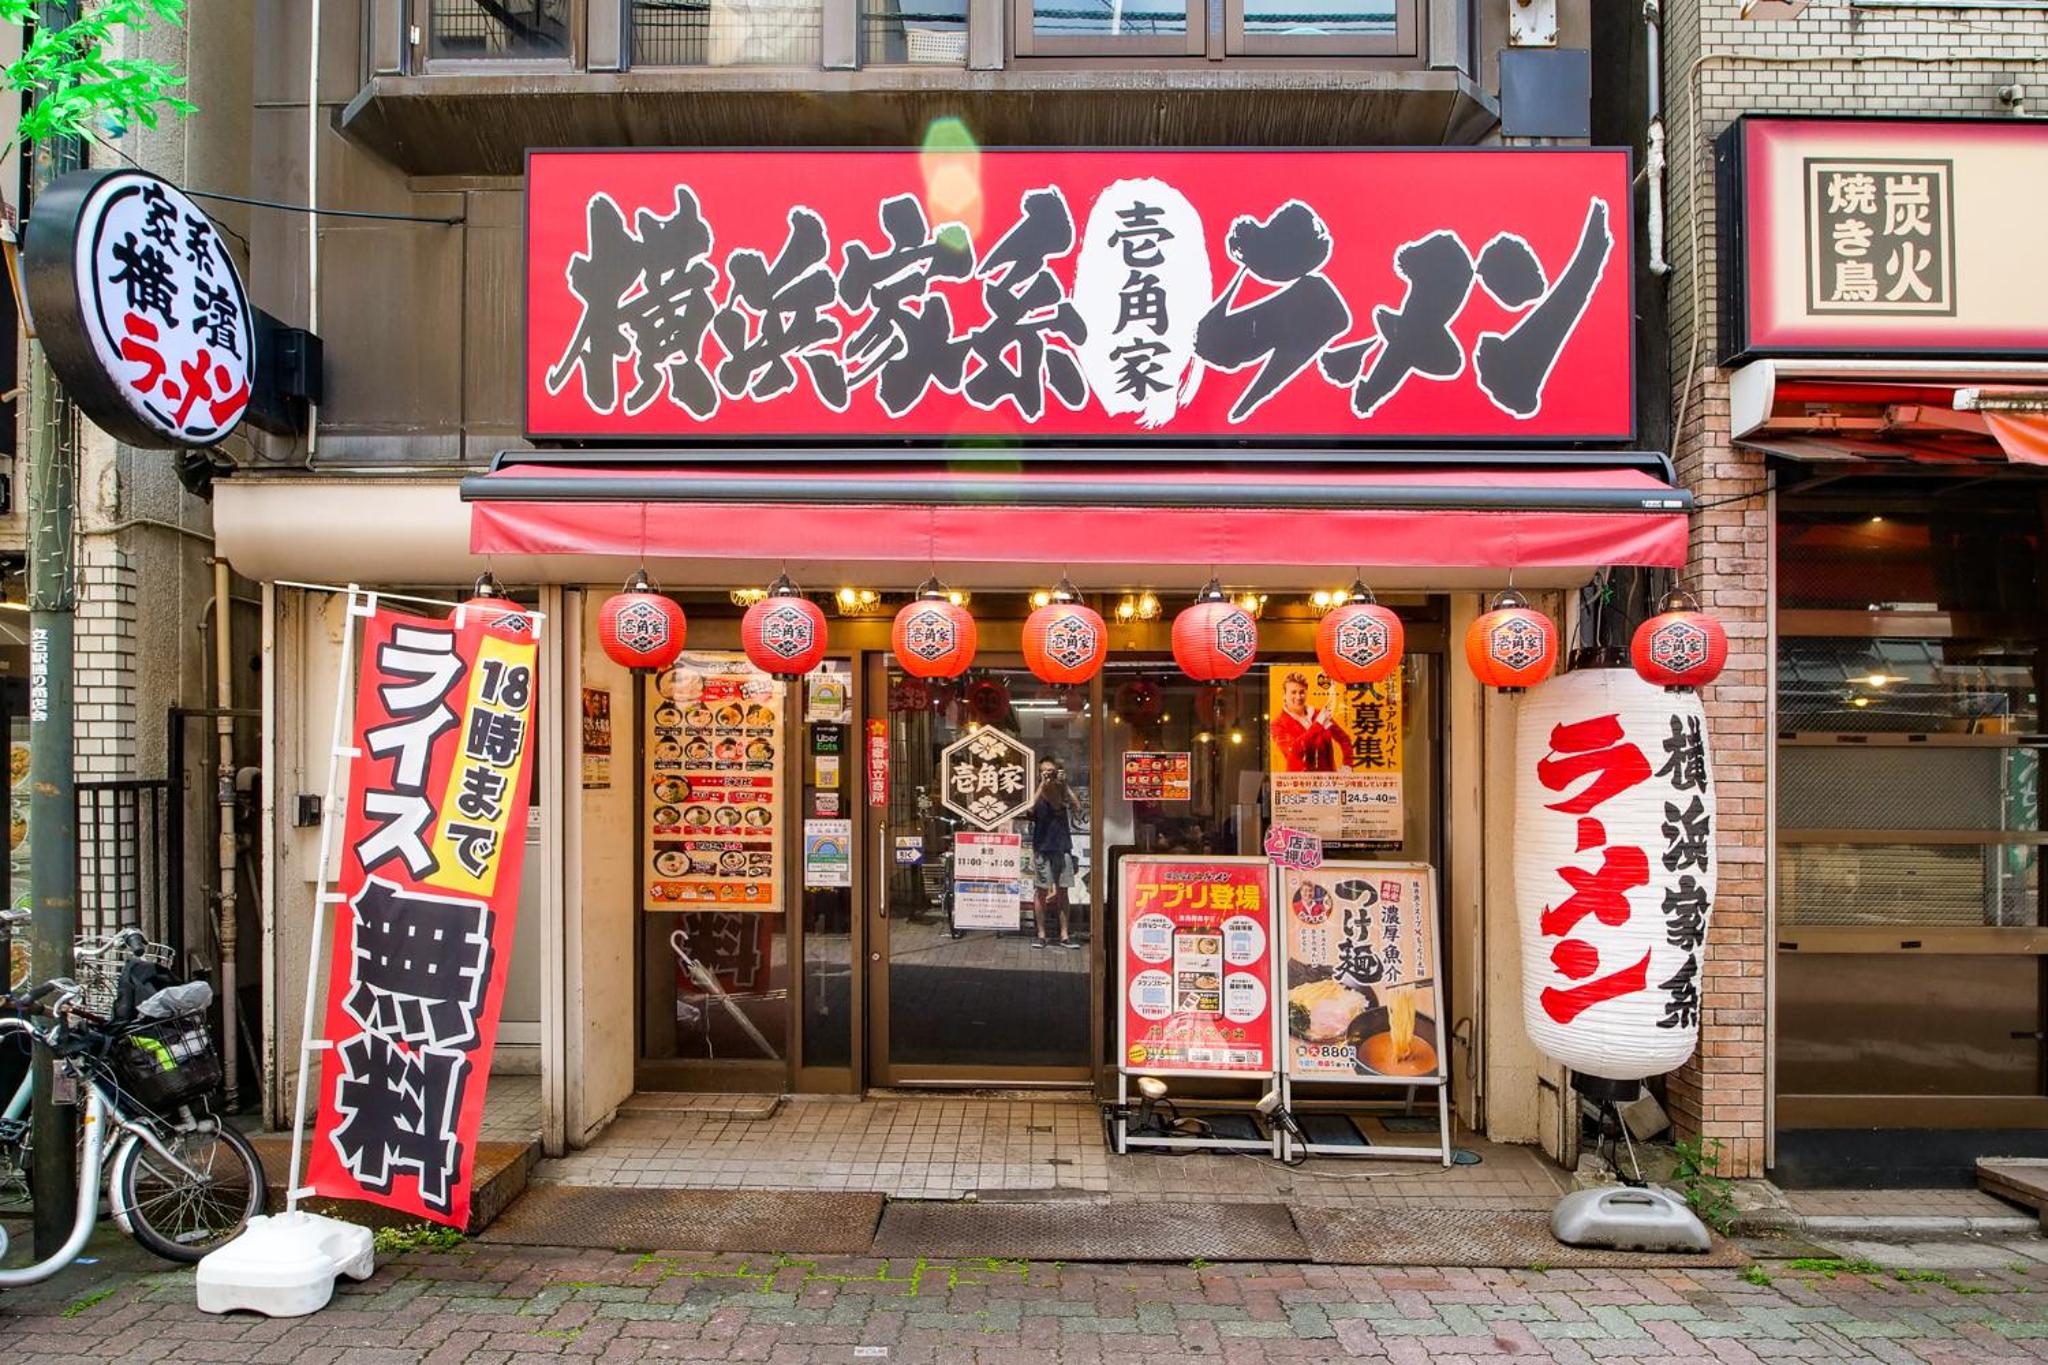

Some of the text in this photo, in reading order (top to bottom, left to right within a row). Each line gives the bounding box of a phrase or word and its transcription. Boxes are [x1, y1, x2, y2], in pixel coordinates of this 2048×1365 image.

[1828, 174, 1878, 302] 焼き鳥
[1883, 175, 1932, 302] 炭火
[546, 184, 1615, 424] 横浜家系 ラーメン
[1107, 200, 1176, 401] 壱角家
[119, 312, 250, 428] ラーメン
[621, 619, 662, 635] 壱角家
[769, 623, 808, 638] 壱角家
[910, 627, 950, 643] 壱角家
[1051, 634, 1091, 650] 壱角家
[1342, 633, 1383, 648] 壱角家
[1497, 634, 1539, 652] 壱角家
[1657, 636, 1702, 655] 壱角家
[354, 622, 467, 880] ライス
[446, 658, 533, 879] 18時まで
[816, 733, 838, 742] Uber
[816, 742, 838, 750] Eats
[951, 762, 1025, 795] 壱角家
[1135, 883, 1261, 910] アプリ登場
[1537, 714, 1653, 1024] ラーメン
[1655, 714, 1711, 1028] 横浜家系
[1334, 878, 1384, 984] つけ麺
[1380, 905, 1403, 983] 濃厚魚介
[330, 874, 496, 1212] 無料
